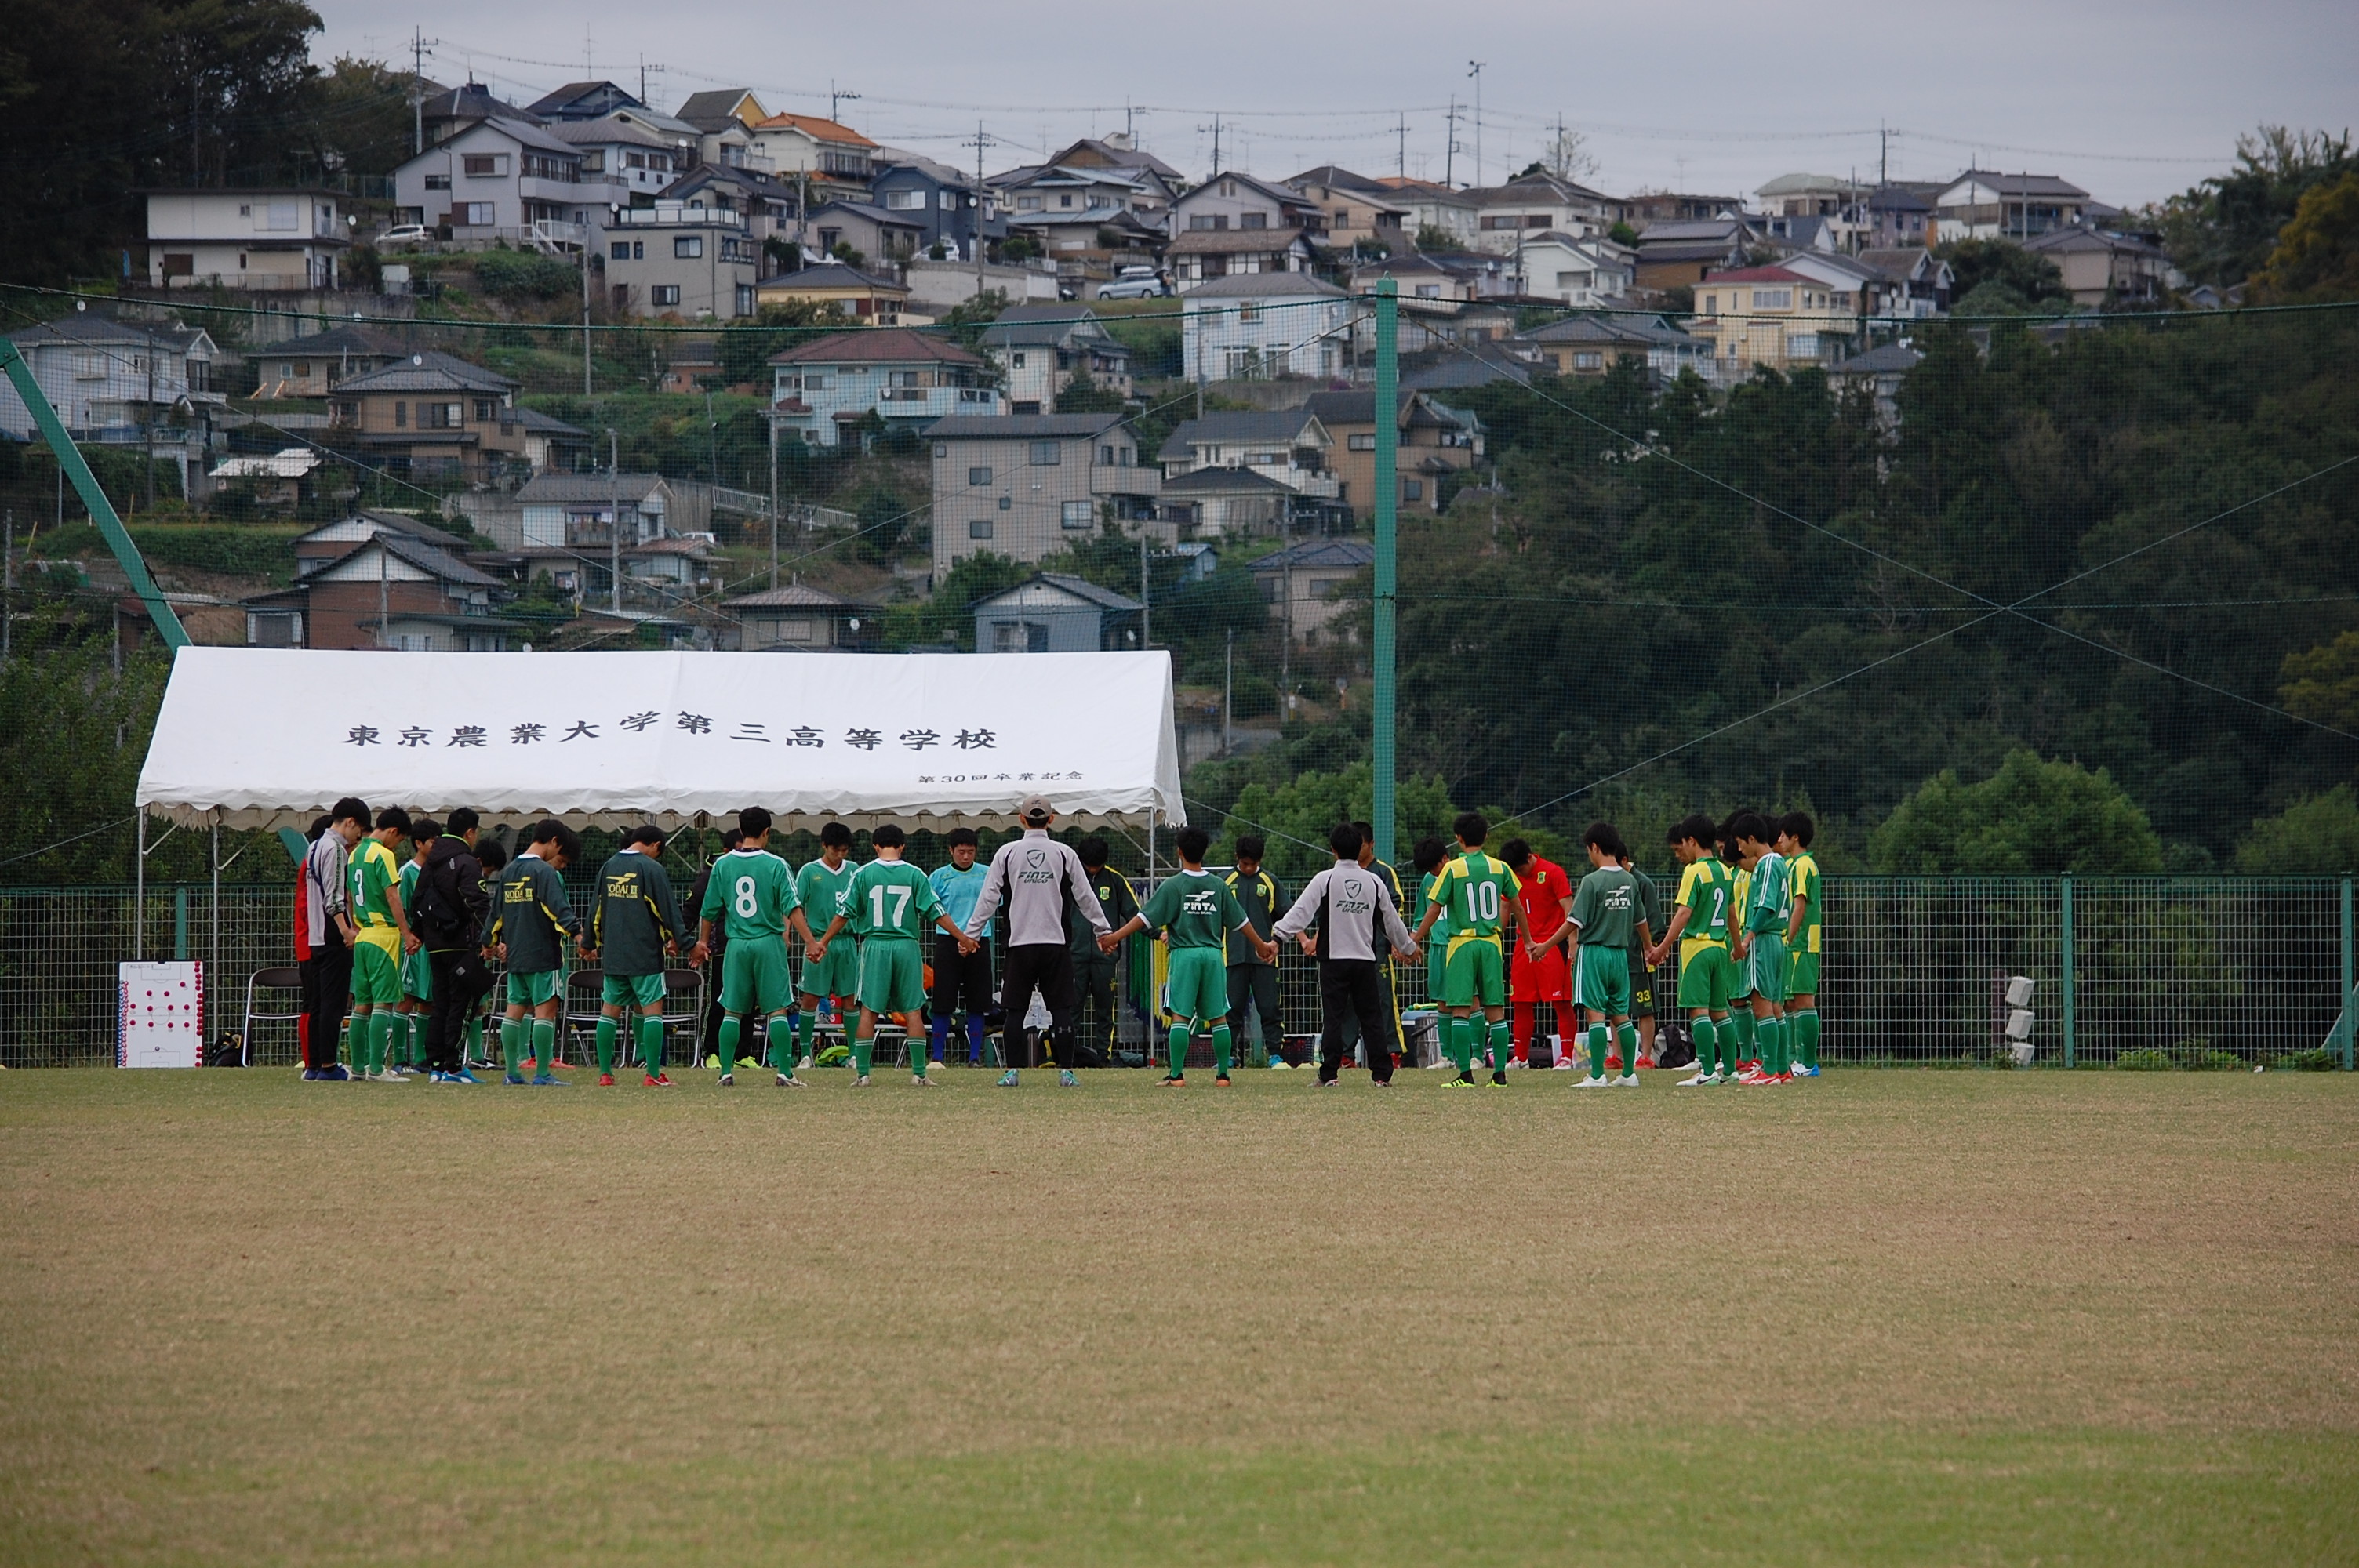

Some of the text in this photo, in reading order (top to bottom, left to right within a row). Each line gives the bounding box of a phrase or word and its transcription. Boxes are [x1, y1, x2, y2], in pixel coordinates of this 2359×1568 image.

[342, 710, 997, 751] 東京農業大学第三高等学校
[918, 771, 1084, 783] 第30回卒業記念
[354, 869, 364, 907] 3
[735, 875, 758, 918] 8
[869, 884, 912, 927] 17
[1183, 902, 1217, 912] FINTA
[1466, 880, 1499, 923] 10
[1710, 887, 1725, 927] 2
[1636, 989, 1651, 1004] 33
